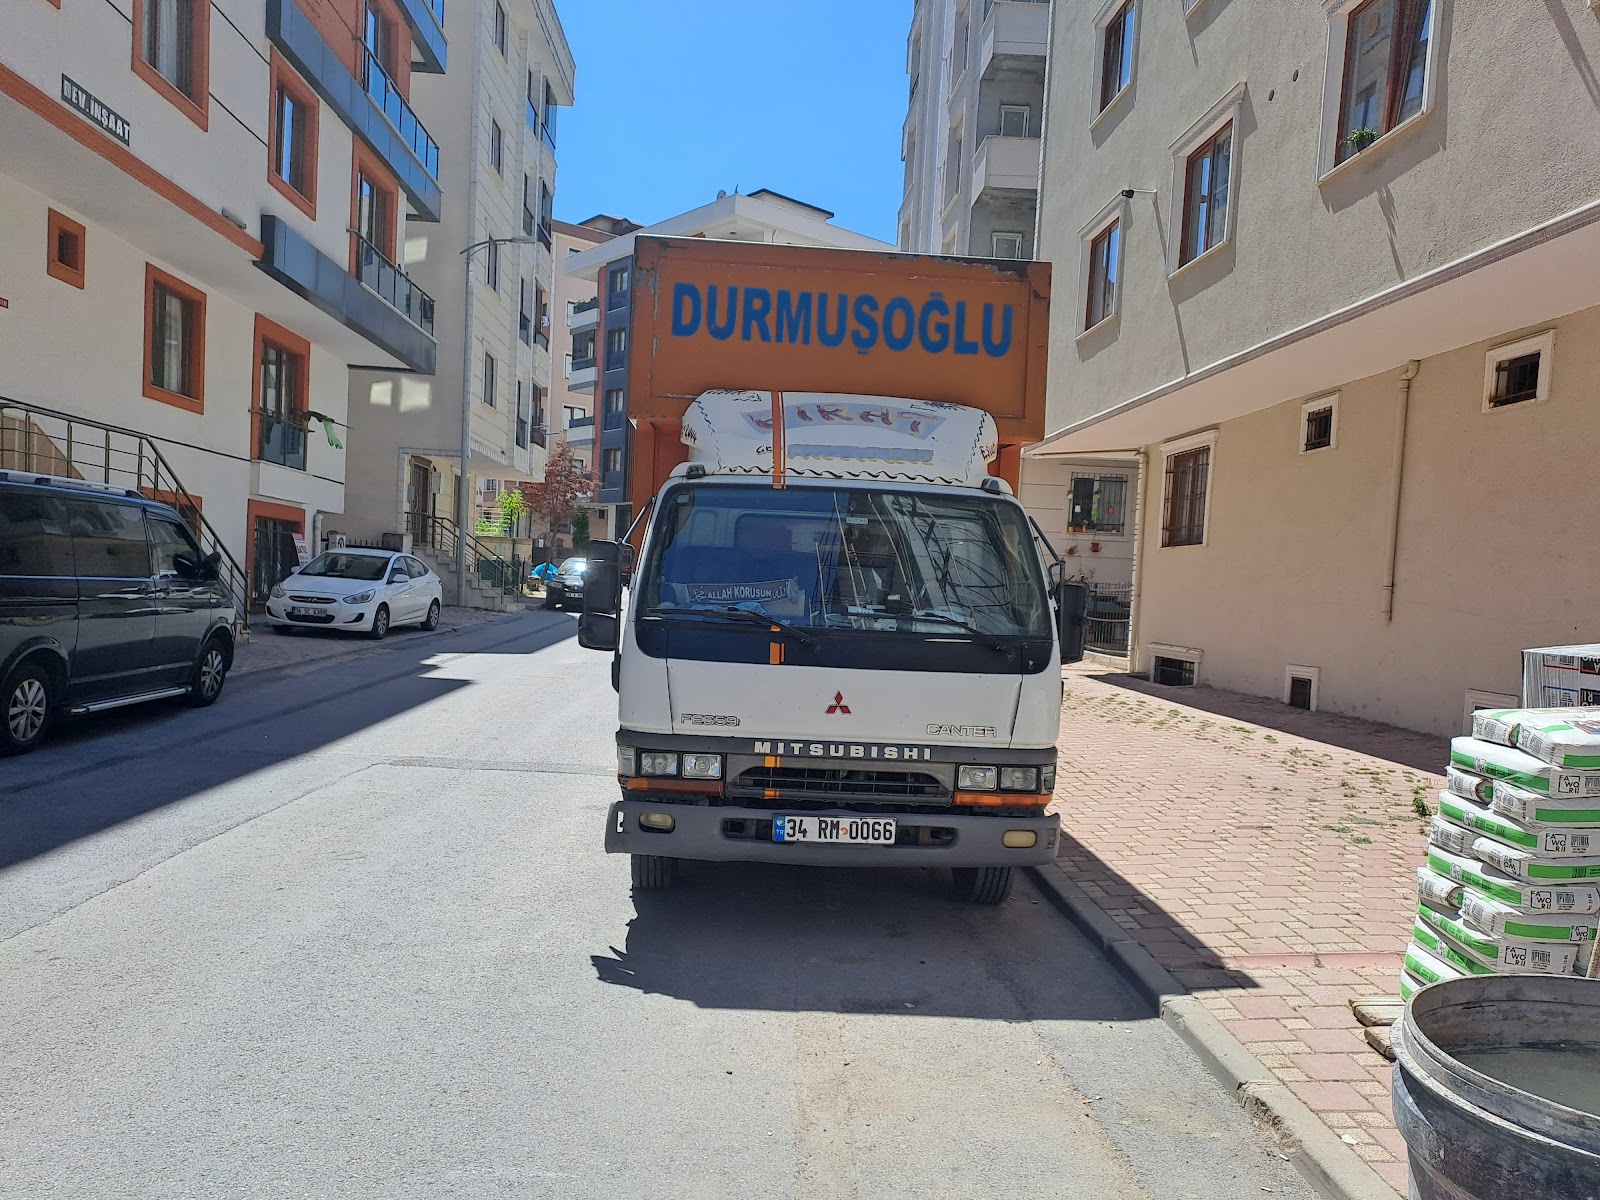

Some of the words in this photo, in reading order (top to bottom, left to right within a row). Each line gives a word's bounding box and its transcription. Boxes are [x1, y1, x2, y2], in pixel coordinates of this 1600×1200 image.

[671, 282, 1013, 358] DURMUŞOĞLU
[707, 586, 732, 599] ALLAH
[734, 585, 772, 599] KORUSUN
[926, 723, 998, 738] CANTER
[754, 741, 931, 760] MITSUBISHI
[786, 818, 808, 839] 34
[818, 820, 840, 840] RM
[849, 820, 893, 841] 0066
